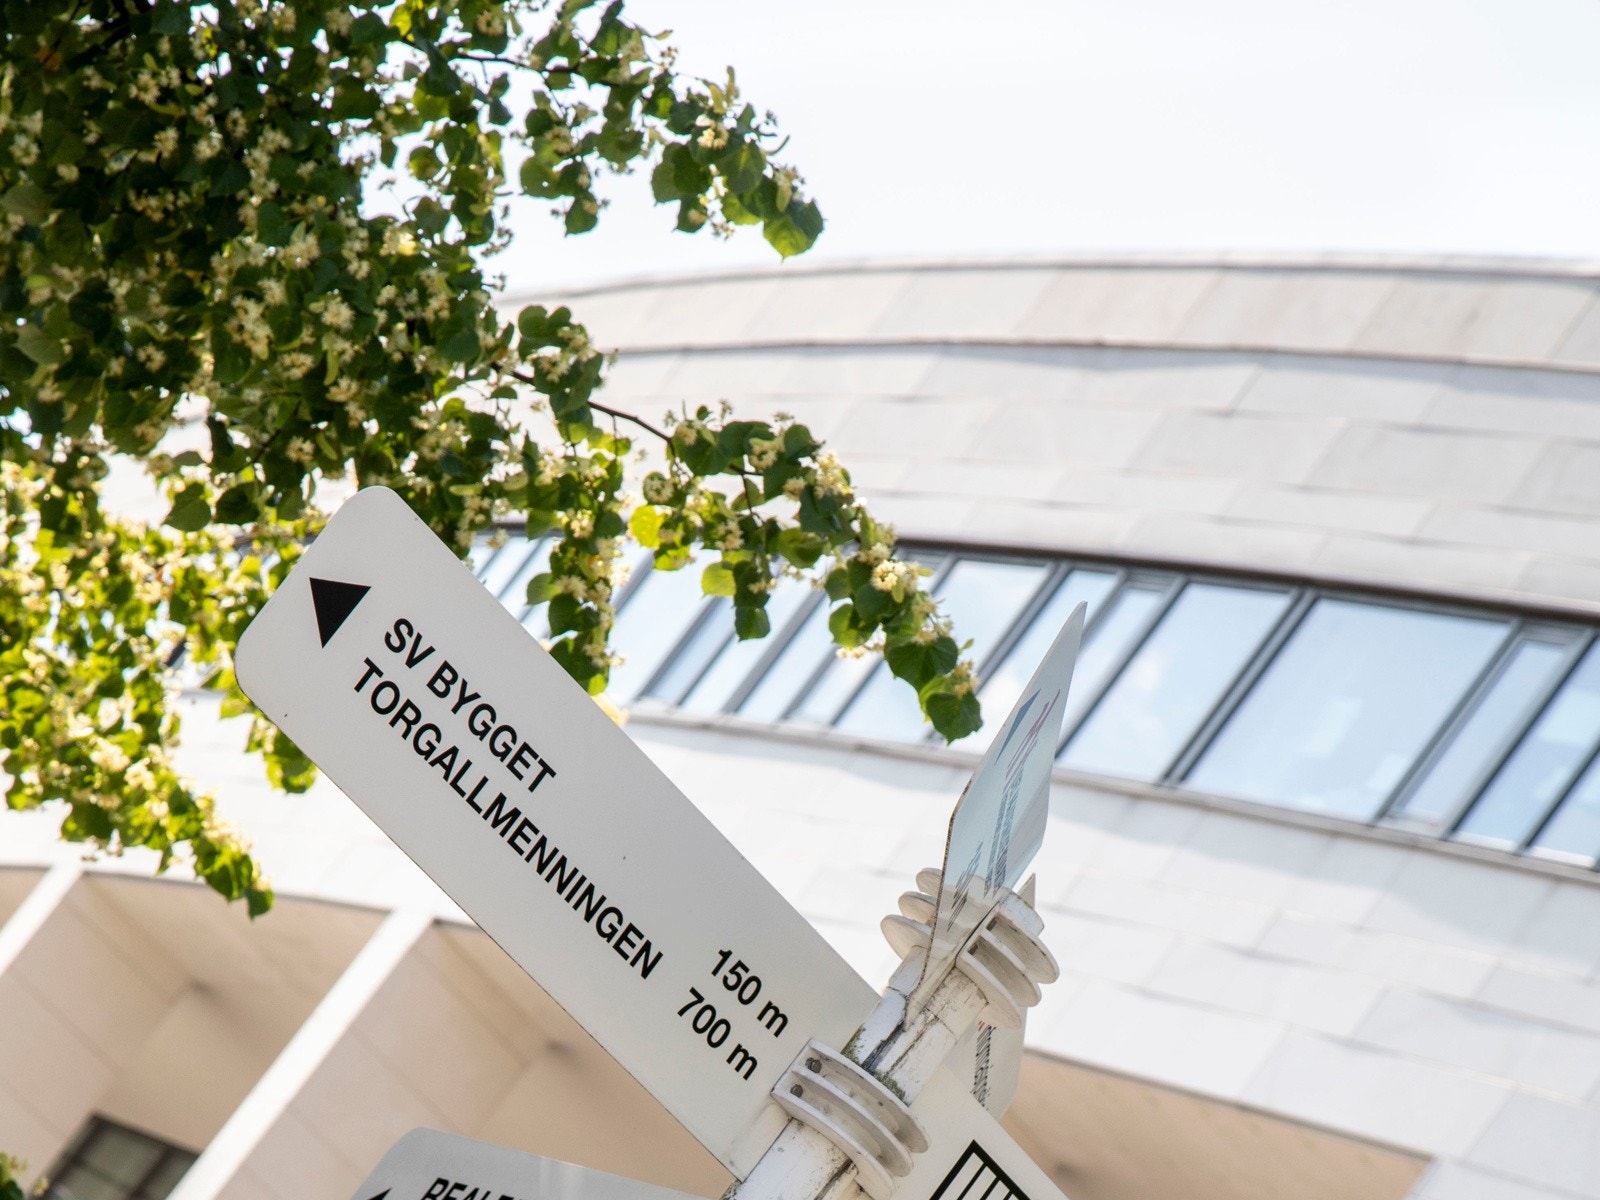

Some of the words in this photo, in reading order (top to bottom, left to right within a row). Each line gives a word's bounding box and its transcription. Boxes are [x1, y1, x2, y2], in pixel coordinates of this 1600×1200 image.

[384, 618, 435, 669] SV
[426, 660, 557, 793] BYGGET
[353, 656, 664, 980] TORGALLMENNINGEN
[677, 986, 732, 1049] 700
[726, 1043, 758, 1081] m
[711, 949, 762, 1006] 150
[756, 1000, 789, 1038] m
